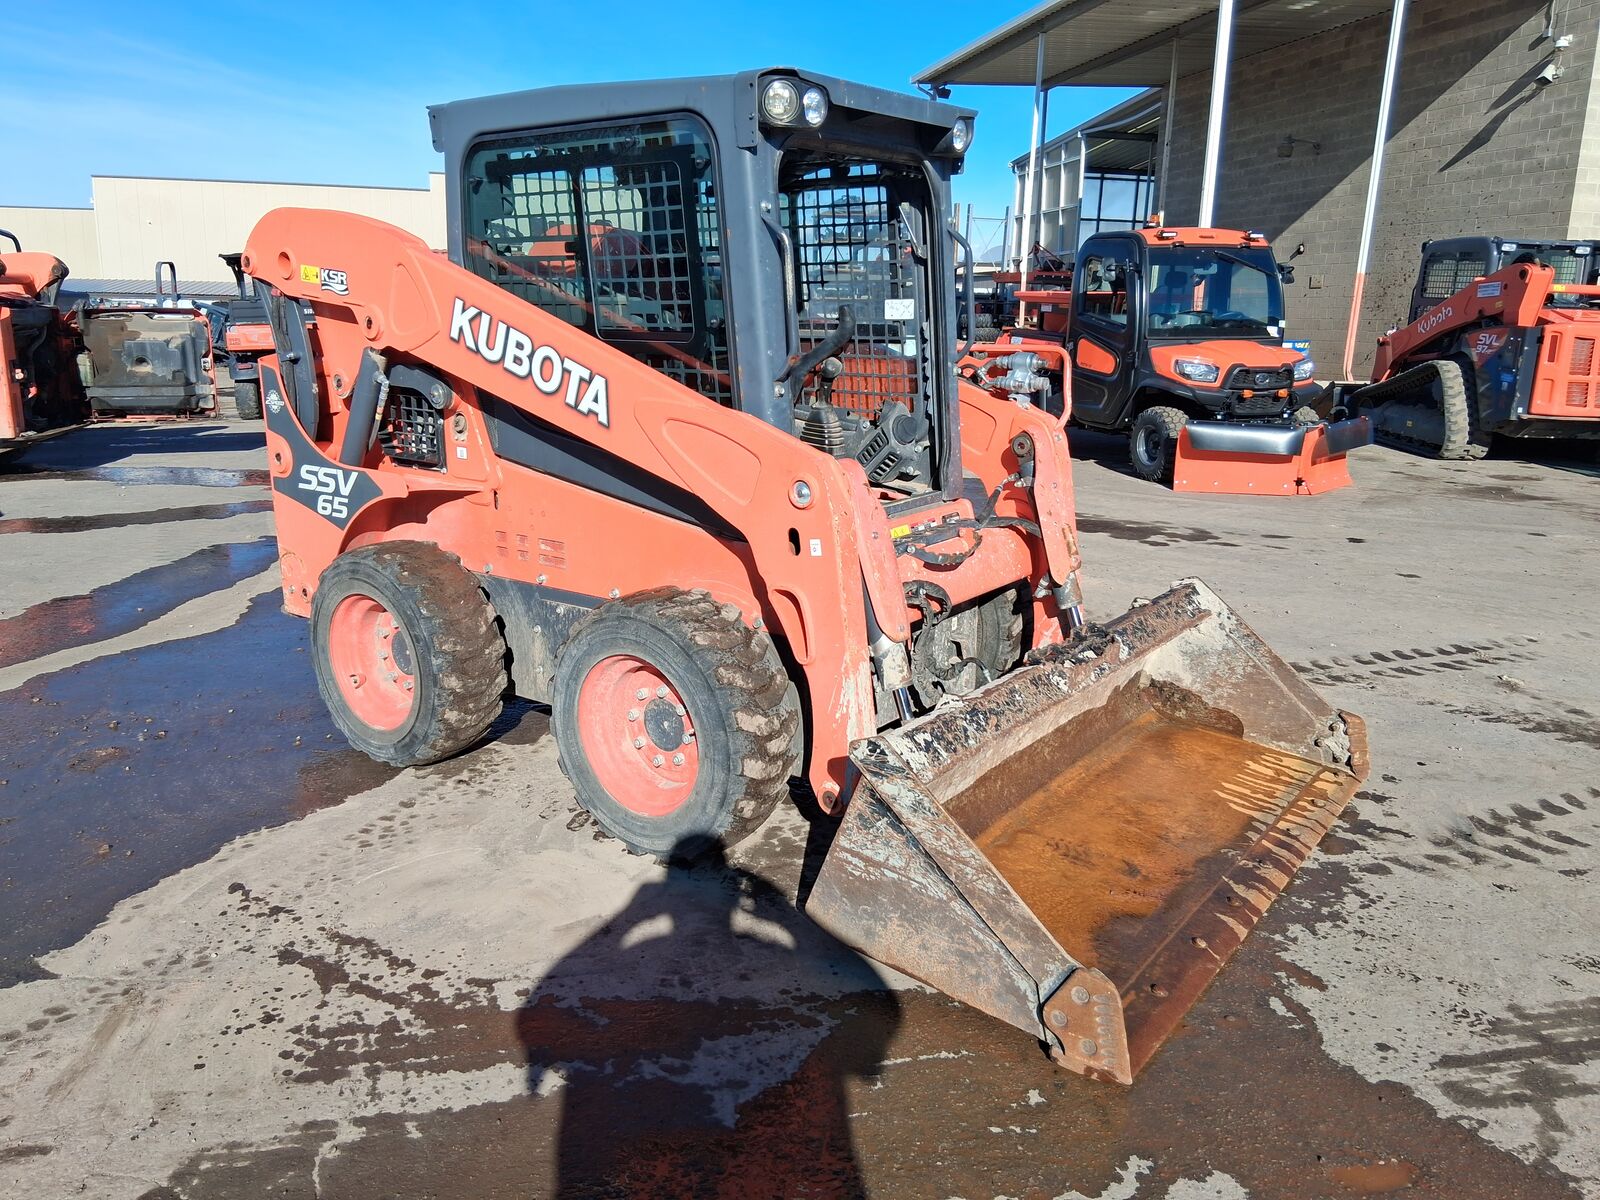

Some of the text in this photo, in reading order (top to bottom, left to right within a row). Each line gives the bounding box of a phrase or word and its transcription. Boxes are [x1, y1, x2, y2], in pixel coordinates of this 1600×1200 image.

[320, 268, 347, 284] KSR
[1418, 306, 1453, 333] Kubota
[1477, 333, 1499, 345] SVL
[449, 297, 609, 427] KUBOTA
[298, 464, 358, 496] SSV
[317, 494, 348, 519] 65
